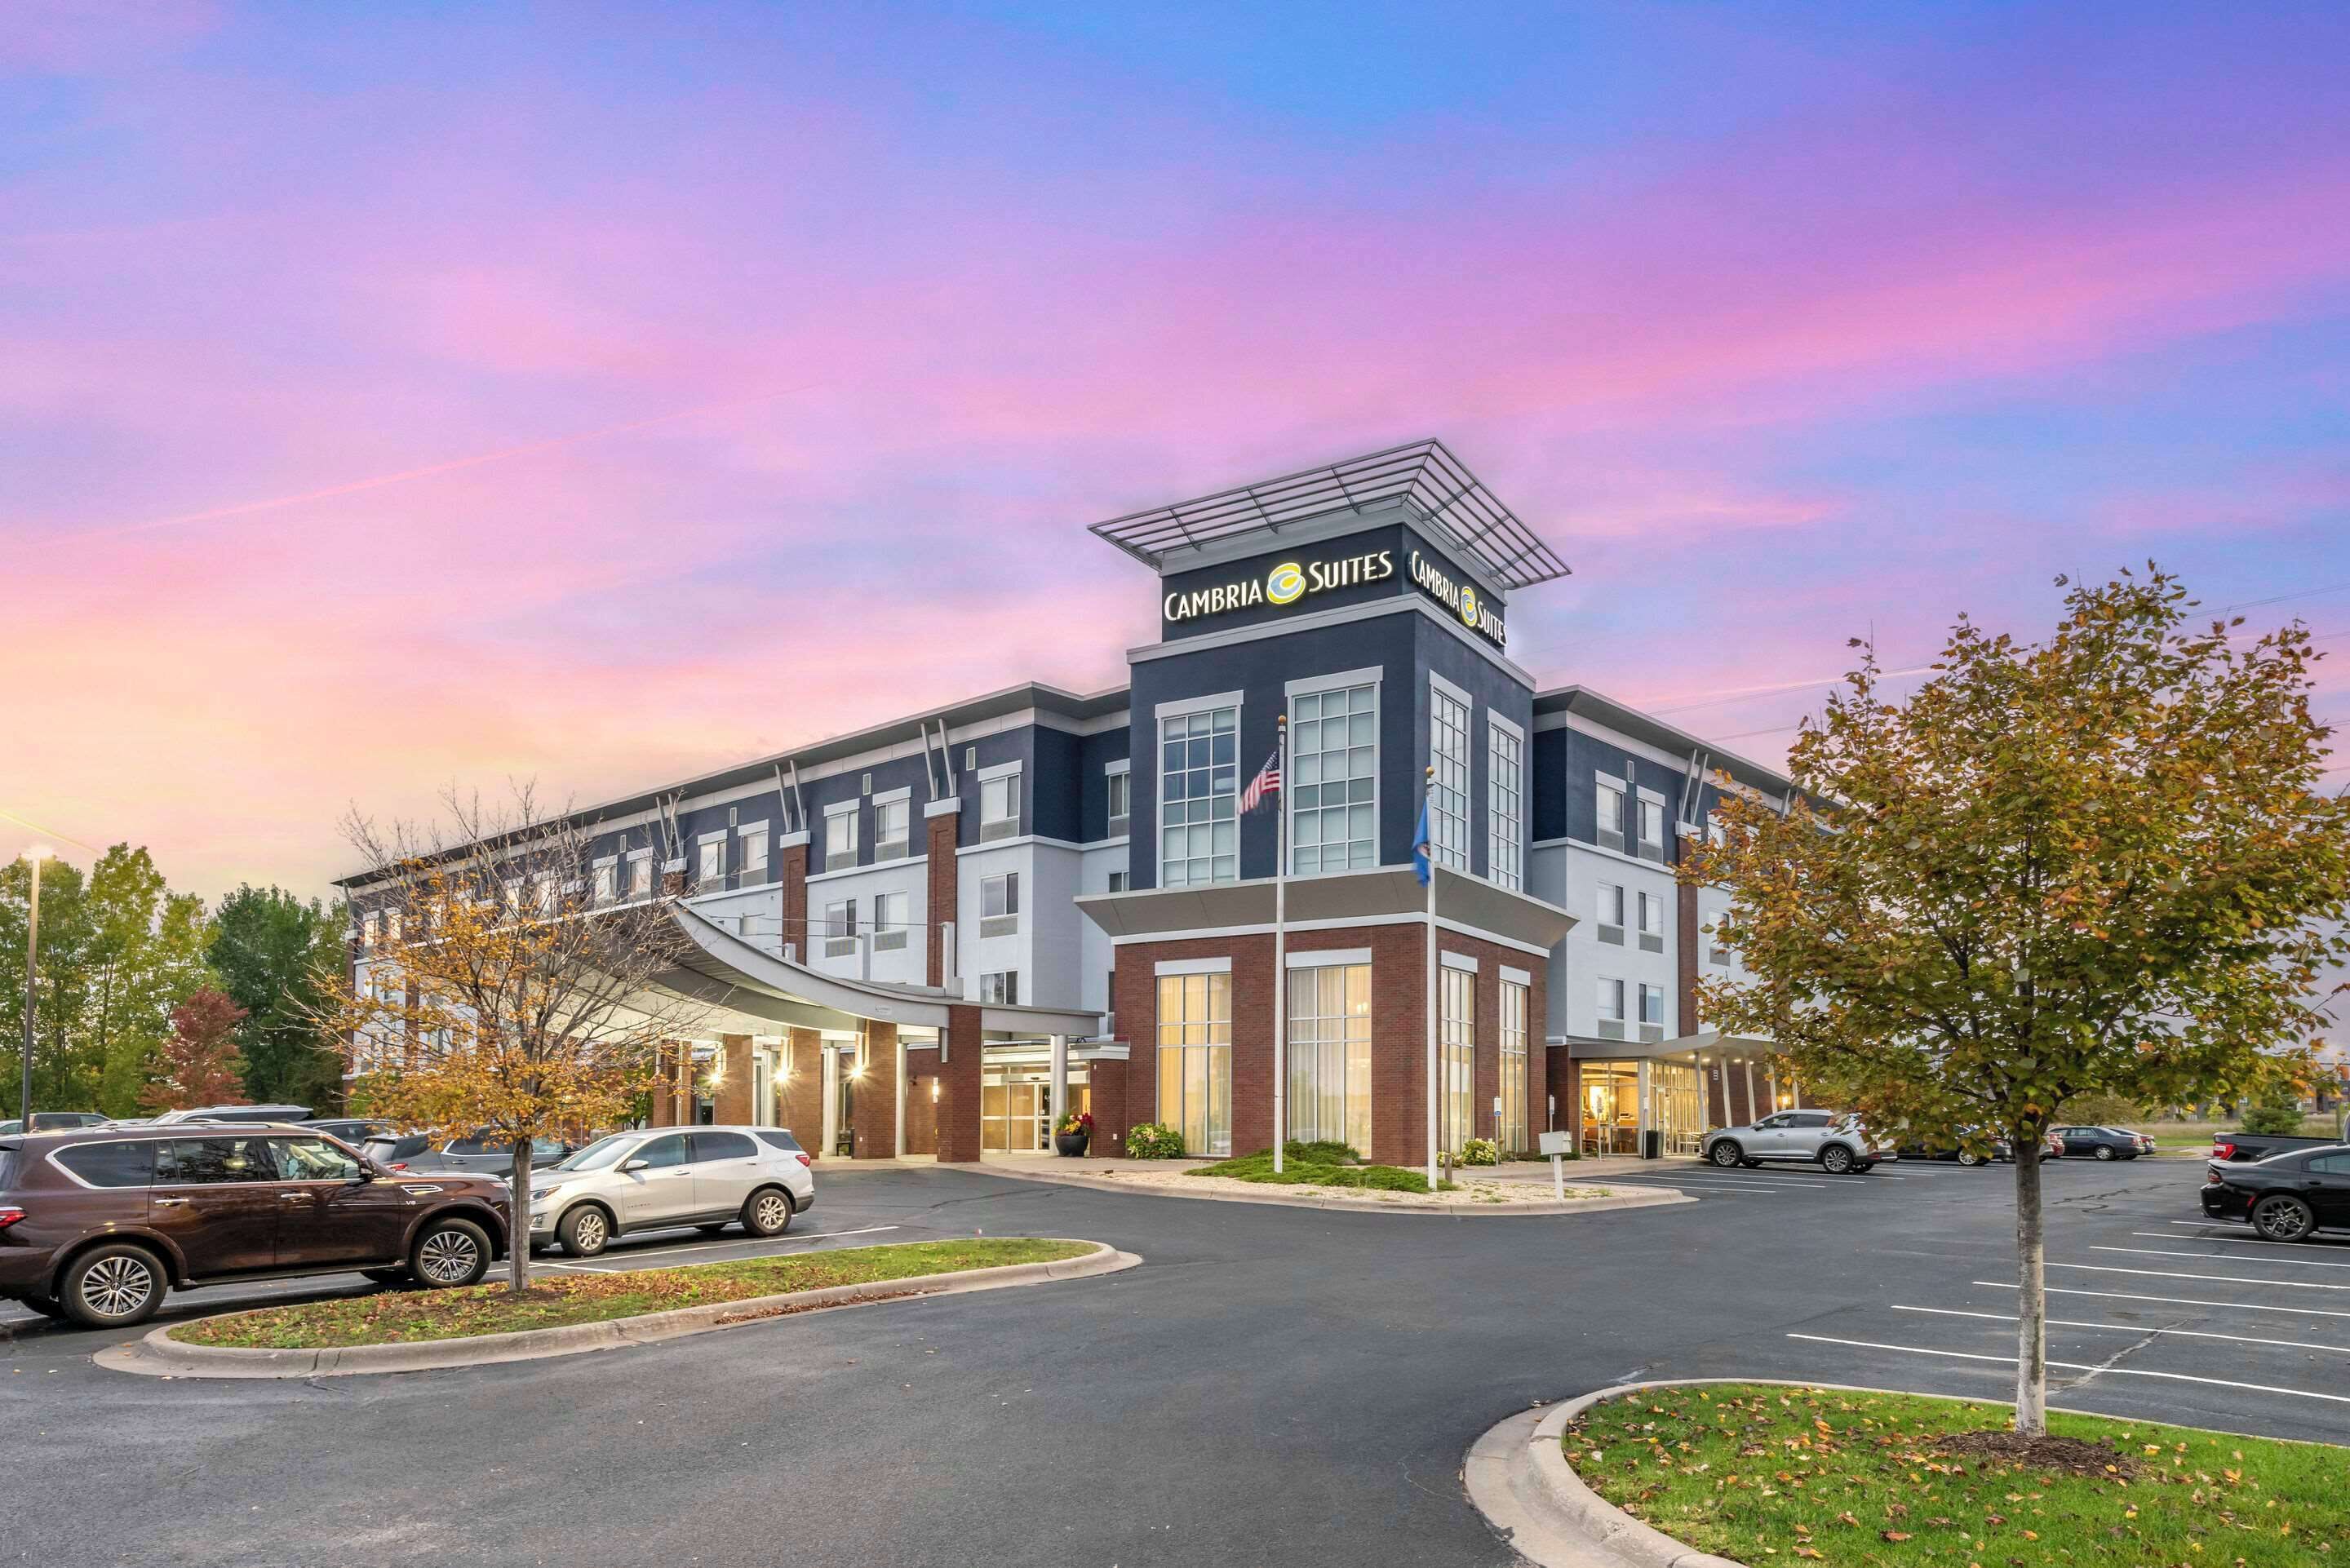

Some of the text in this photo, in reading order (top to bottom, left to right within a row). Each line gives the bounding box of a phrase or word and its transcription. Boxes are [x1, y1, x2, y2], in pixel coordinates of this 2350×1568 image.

[1164, 550, 1393, 621] CAMBRIA SUITES
[1412, 550, 1509, 647] CAMBRIA SUITES
